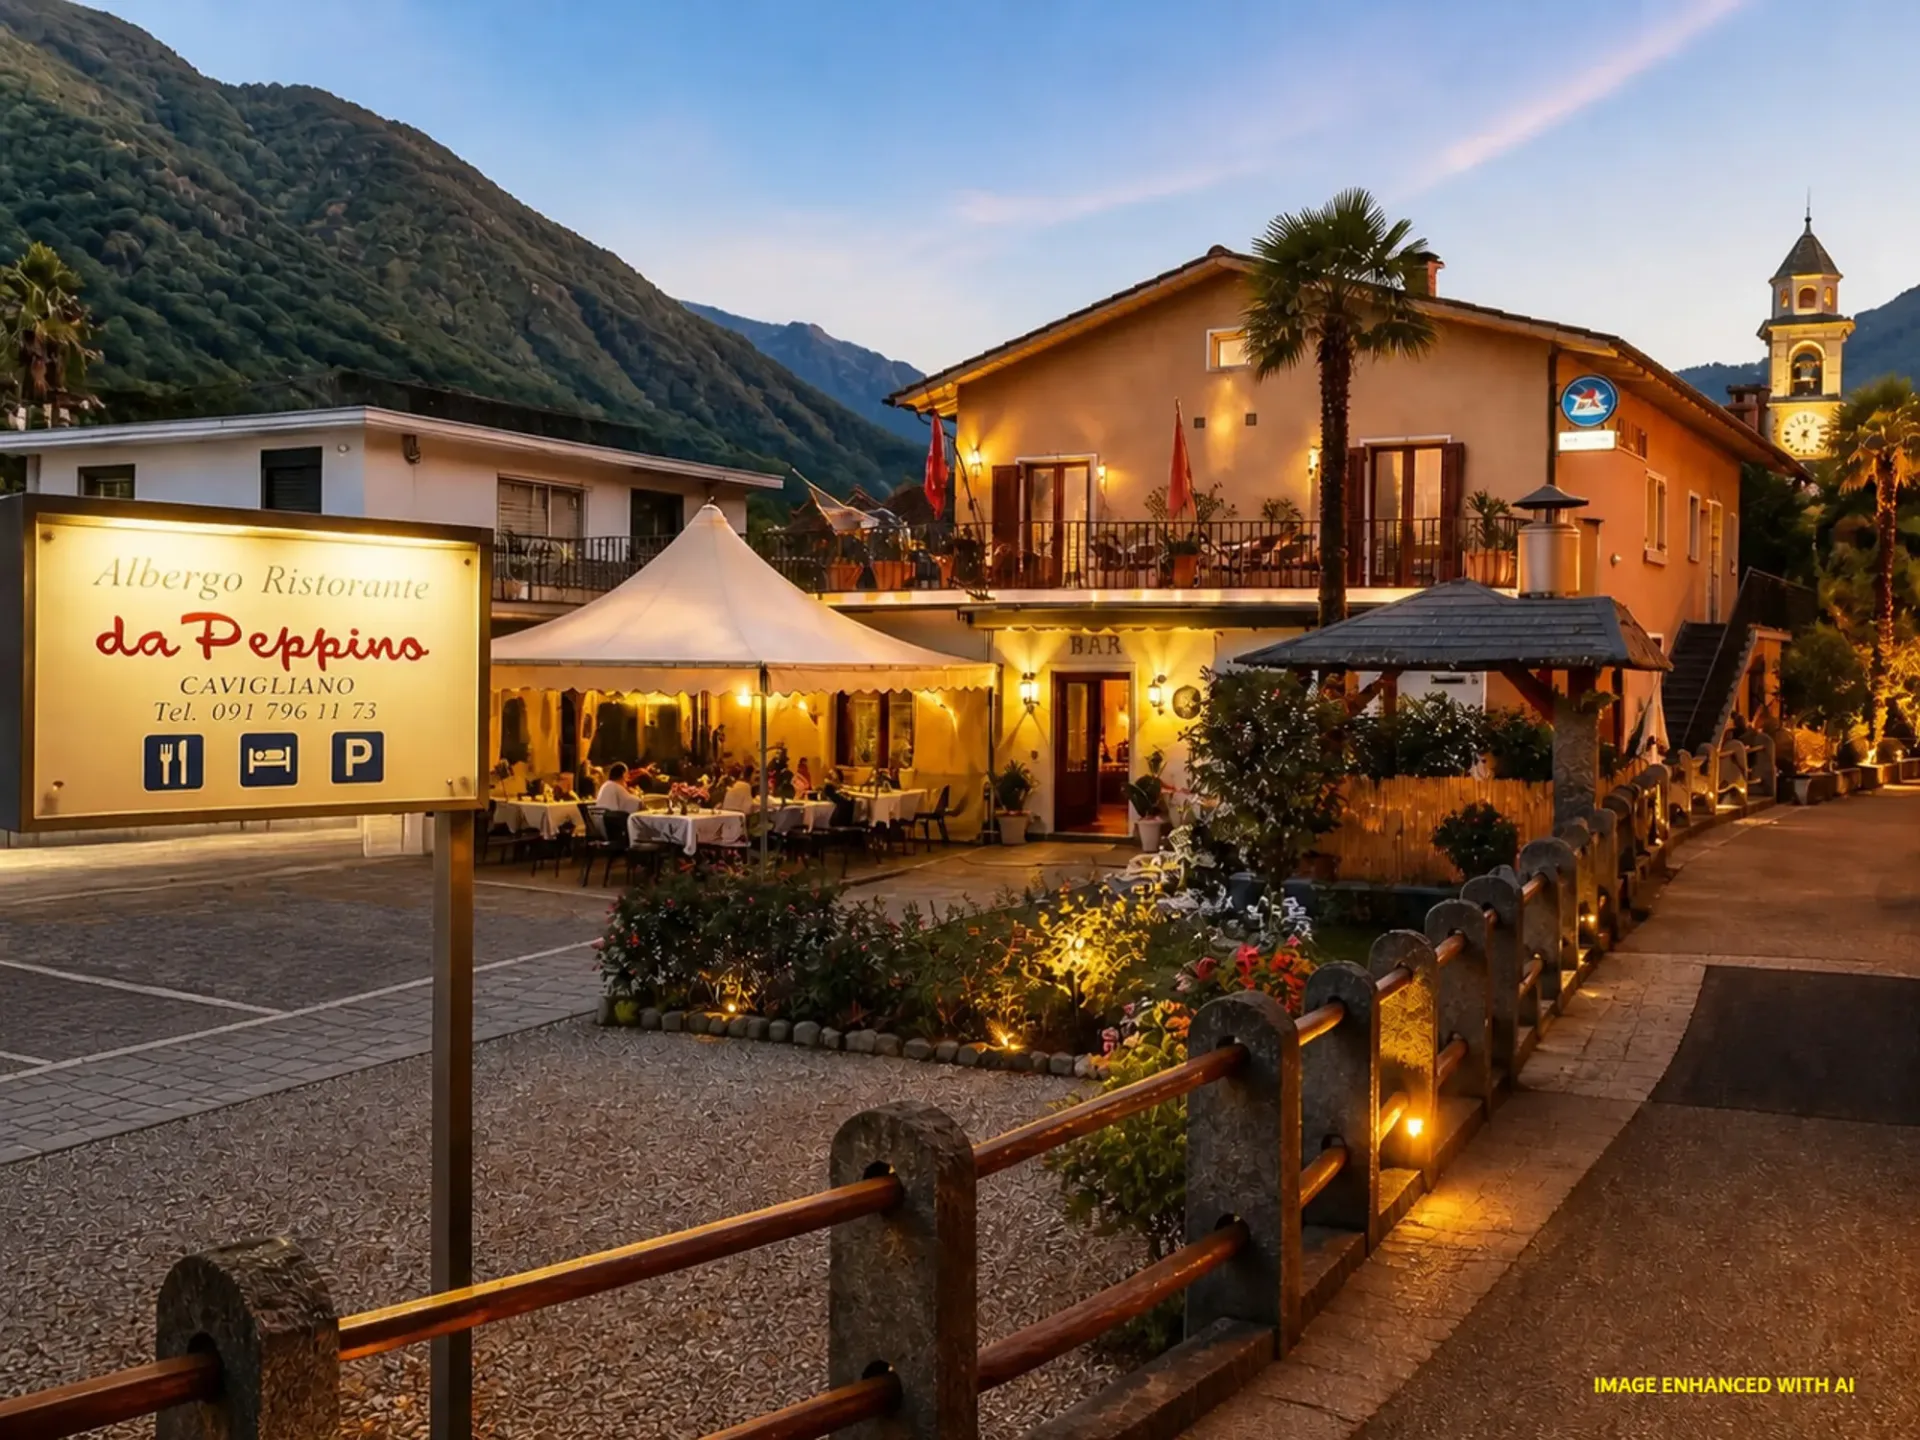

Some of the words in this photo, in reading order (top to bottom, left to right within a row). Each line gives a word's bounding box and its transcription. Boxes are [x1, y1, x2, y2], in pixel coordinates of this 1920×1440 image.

[93, 557, 243, 600] Albergo
[261, 564, 430, 601] Ristorante
[96, 614, 183, 659] da
[181, 611, 430, 672] Peppino
[1069, 635, 1123, 656] BAR
[180, 675, 356, 697] CAVIGLIANO
[154, 702, 197, 721] Tel.
[212, 701, 254, 721] 091
[266, 701, 308, 721] 796
[317, 702, 340, 720] 11
[352, 702, 378, 720] 73
[345, 738, 373, 778] P
